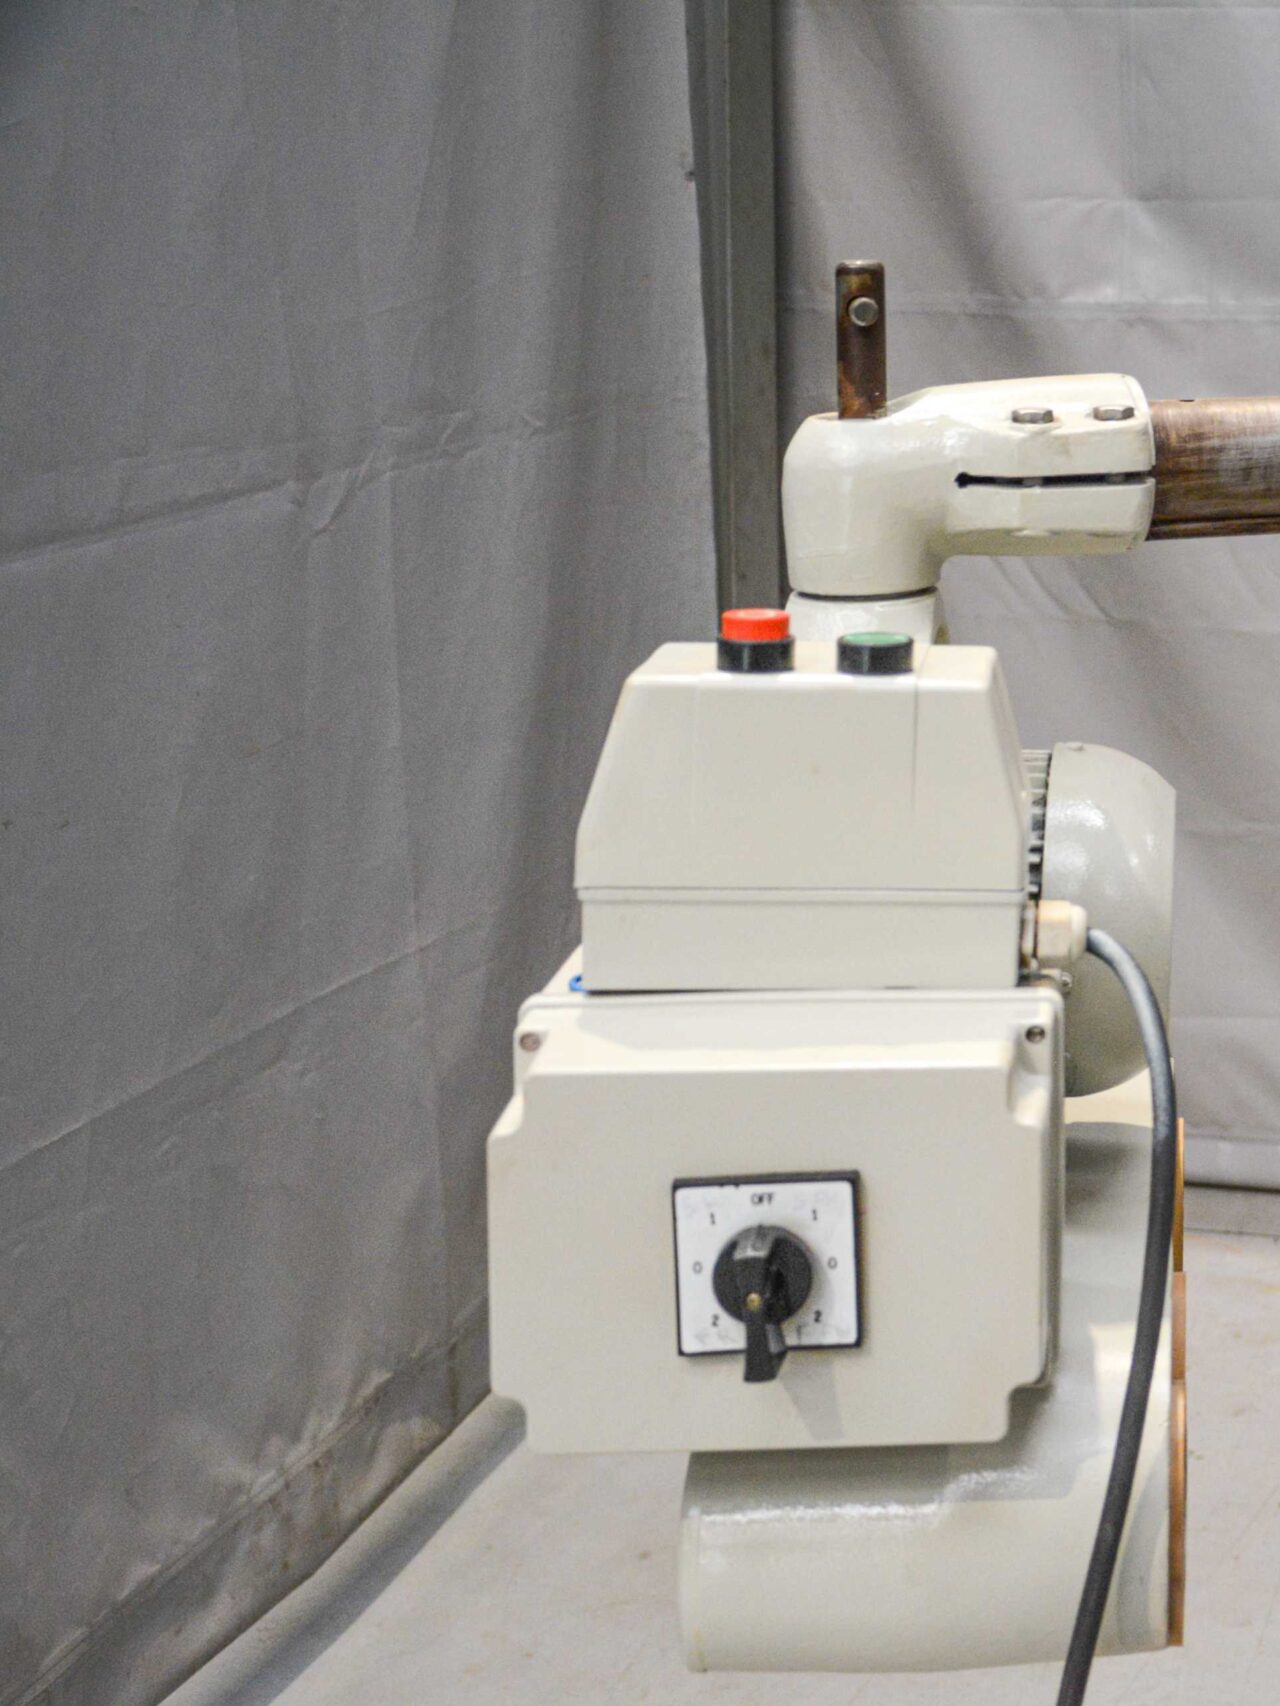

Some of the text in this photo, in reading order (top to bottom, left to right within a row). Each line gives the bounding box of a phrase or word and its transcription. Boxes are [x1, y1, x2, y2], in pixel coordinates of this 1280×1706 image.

[750, 1192, 776, 1206] OFF
[709, 1213, 716, 1225] 1
[811, 1209, 818, 1221] 1
[711, 1314, 720, 1327] 2
[814, 1310, 823, 1323] 2
